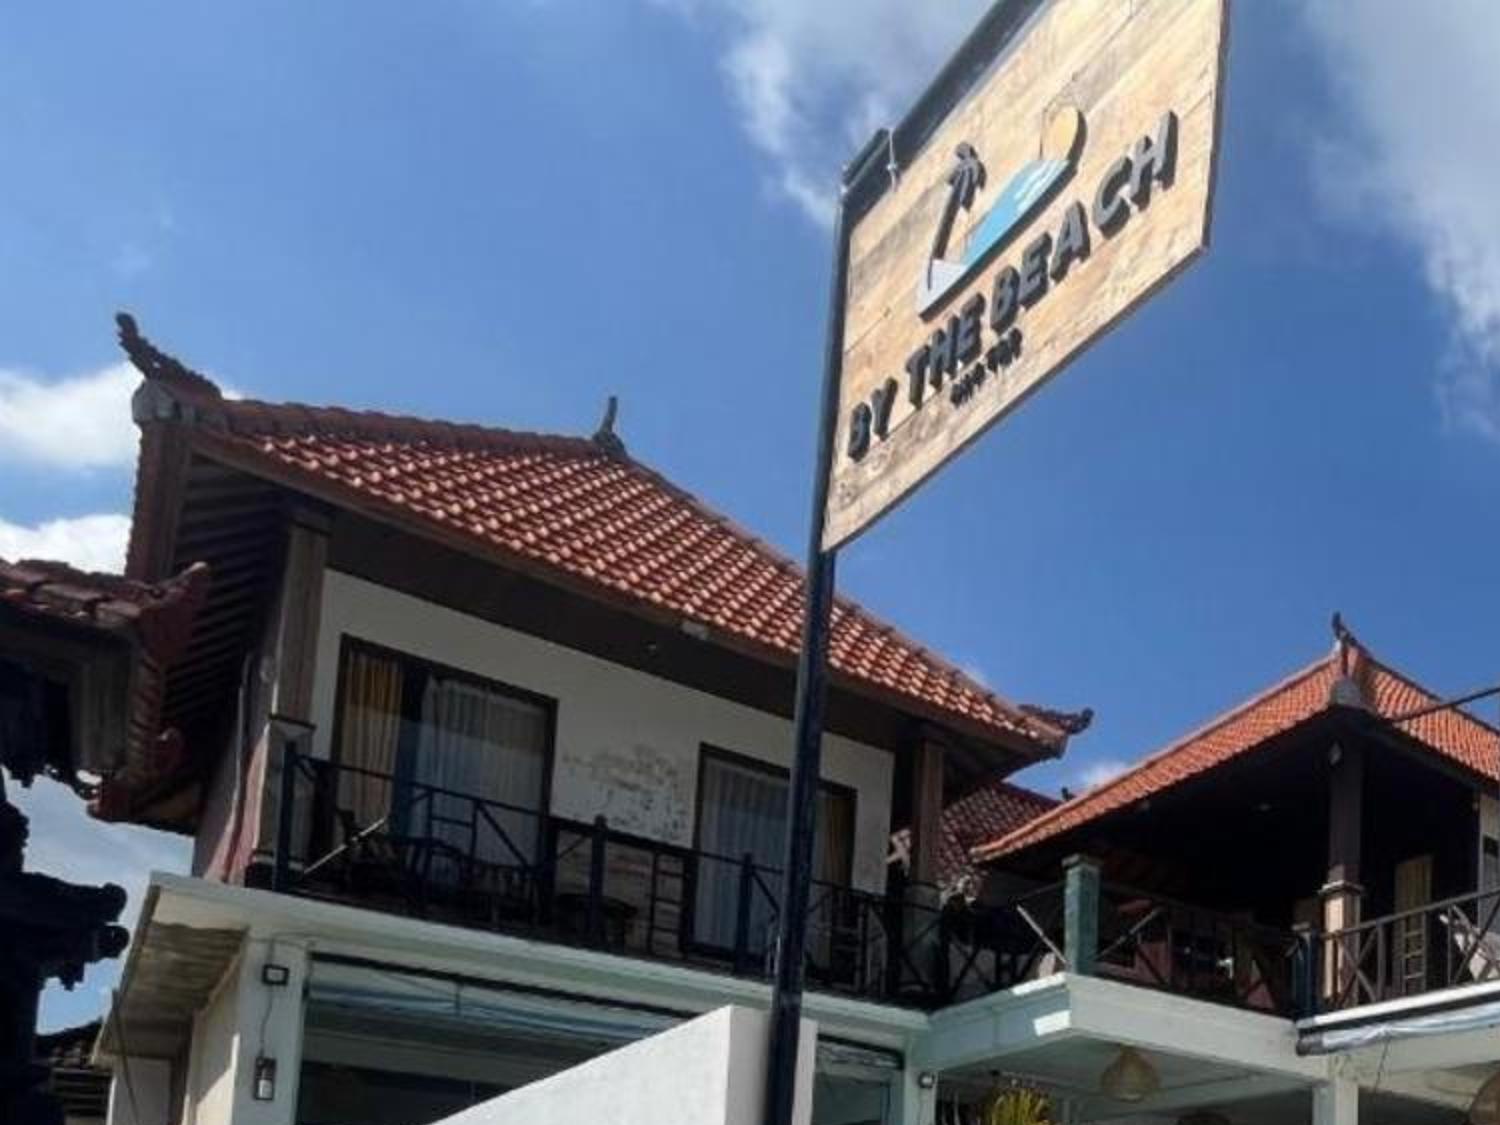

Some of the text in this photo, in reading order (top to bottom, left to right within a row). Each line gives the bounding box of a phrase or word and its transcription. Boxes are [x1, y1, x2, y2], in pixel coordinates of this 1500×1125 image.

[847, 377, 897, 462] BY
[906, 292, 986, 409] THE
[991, 110, 1178, 332] BEACH
